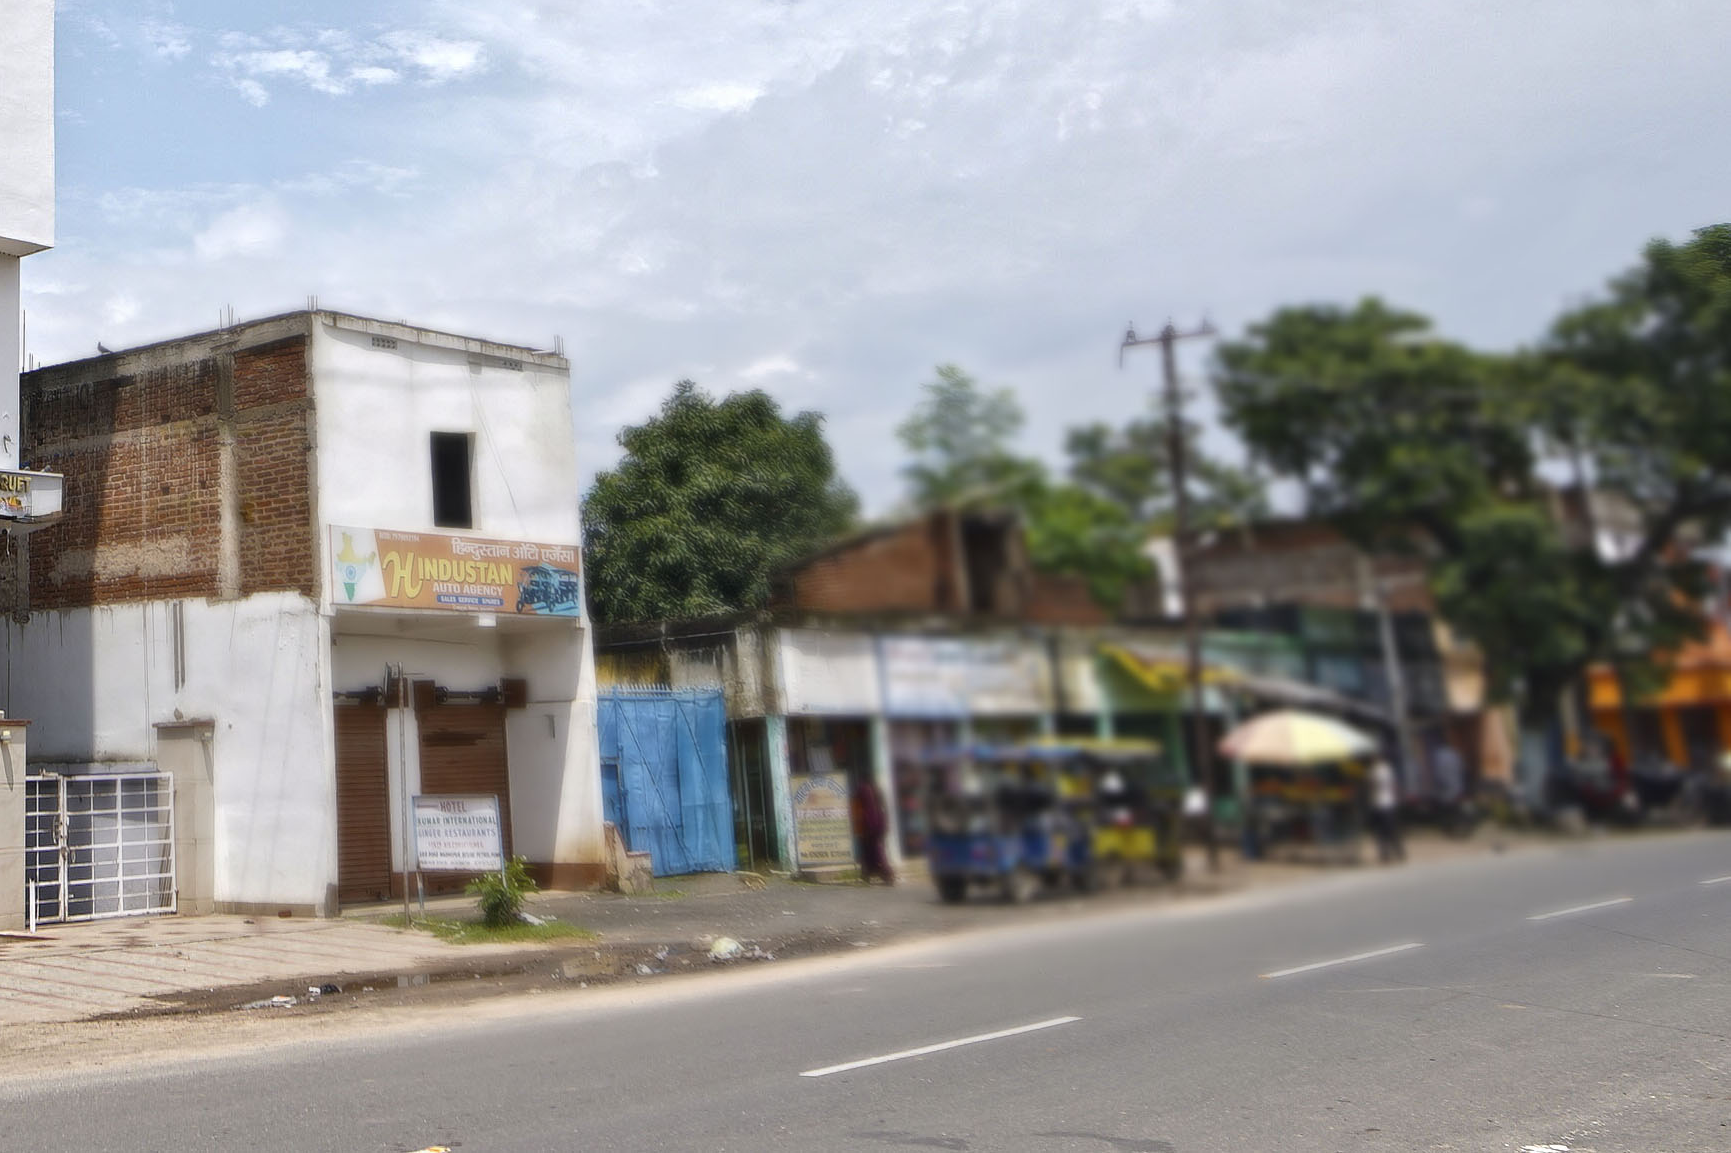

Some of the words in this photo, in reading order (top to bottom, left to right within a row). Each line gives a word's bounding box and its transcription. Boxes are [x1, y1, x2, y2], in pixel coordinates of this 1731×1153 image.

[382, 550, 513, 599] HINDUSTAN
[433, 582, 461, 594] AUTO
[463, 583, 504, 597] AGENCY
[439, 800, 468, 813] HOTEL
[443, 815, 497, 825] INTERNATIONAL
[444, 828, 496, 838] RESTAURANTS
